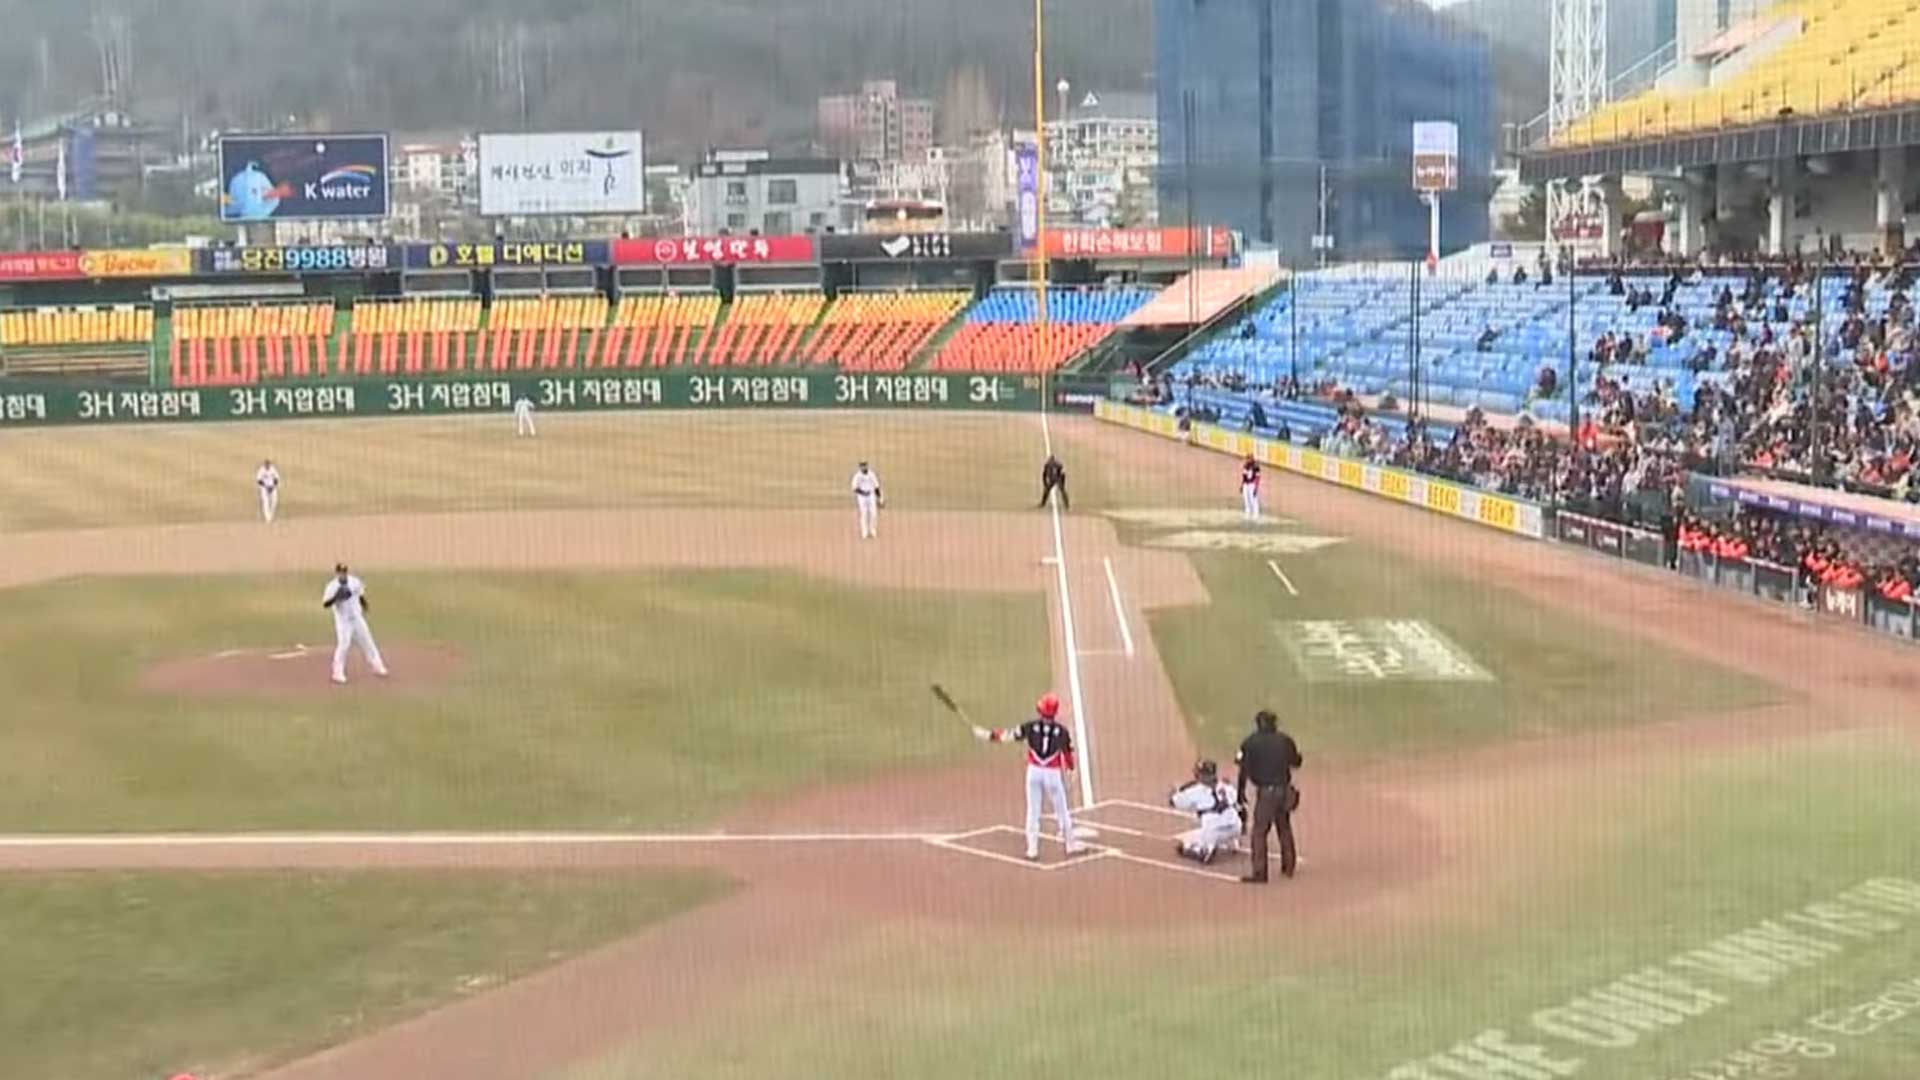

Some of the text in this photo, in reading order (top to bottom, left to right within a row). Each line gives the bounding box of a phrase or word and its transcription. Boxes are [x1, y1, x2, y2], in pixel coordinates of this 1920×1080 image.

[321, 183, 371, 198] water
[456, 243, 495, 264] 호텔
[503, 242, 583, 264] 디에디션
[230, 386, 355, 414] 3H 지압침대
[387, 381, 511, 410] 3H 지압침대
[539, 378, 662, 405] 3H 지압침대
[689, 376, 809, 402] 3H 지압침대
[835, 375, 948, 401] 3H 지압침대
[78, 390, 200, 417] 3H 지압침대
